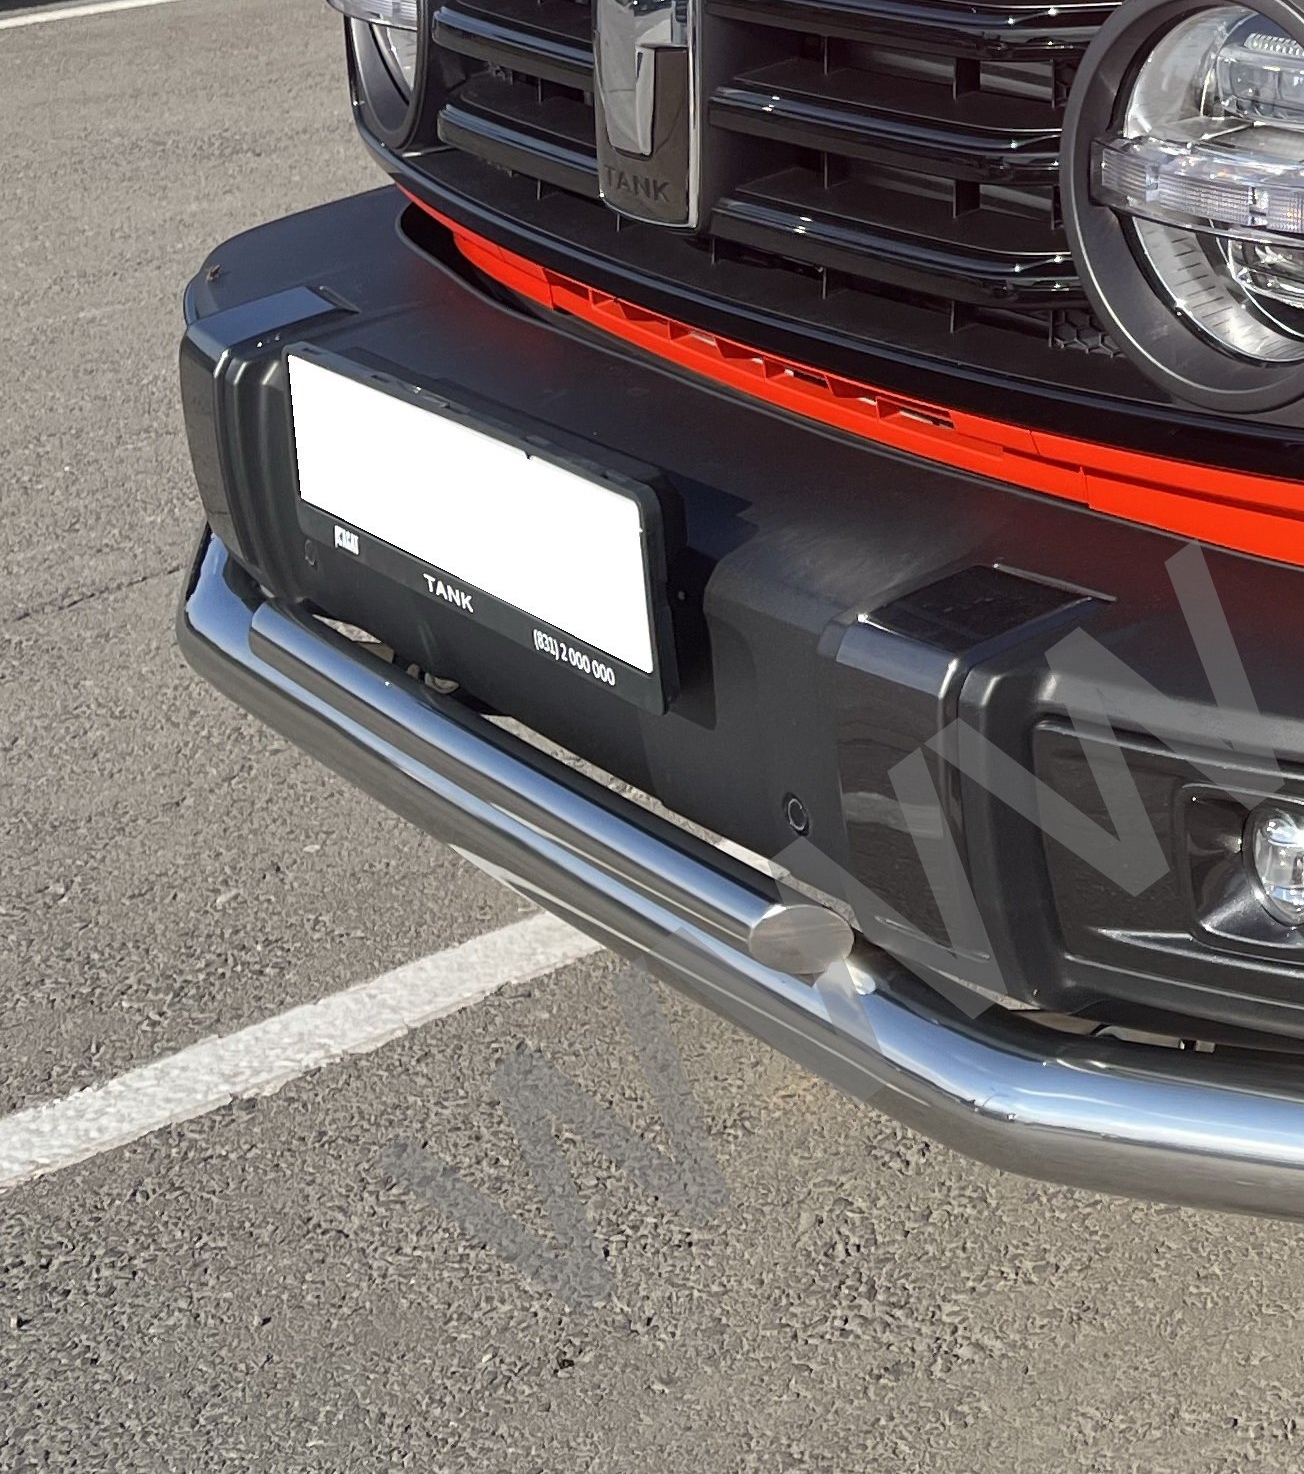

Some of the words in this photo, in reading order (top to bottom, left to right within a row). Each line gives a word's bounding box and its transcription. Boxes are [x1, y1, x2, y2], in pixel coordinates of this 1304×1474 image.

[604, 165, 671, 203] TANK
[423, 572, 474, 613] TANK
[533, 628, 560, 662] (831)
